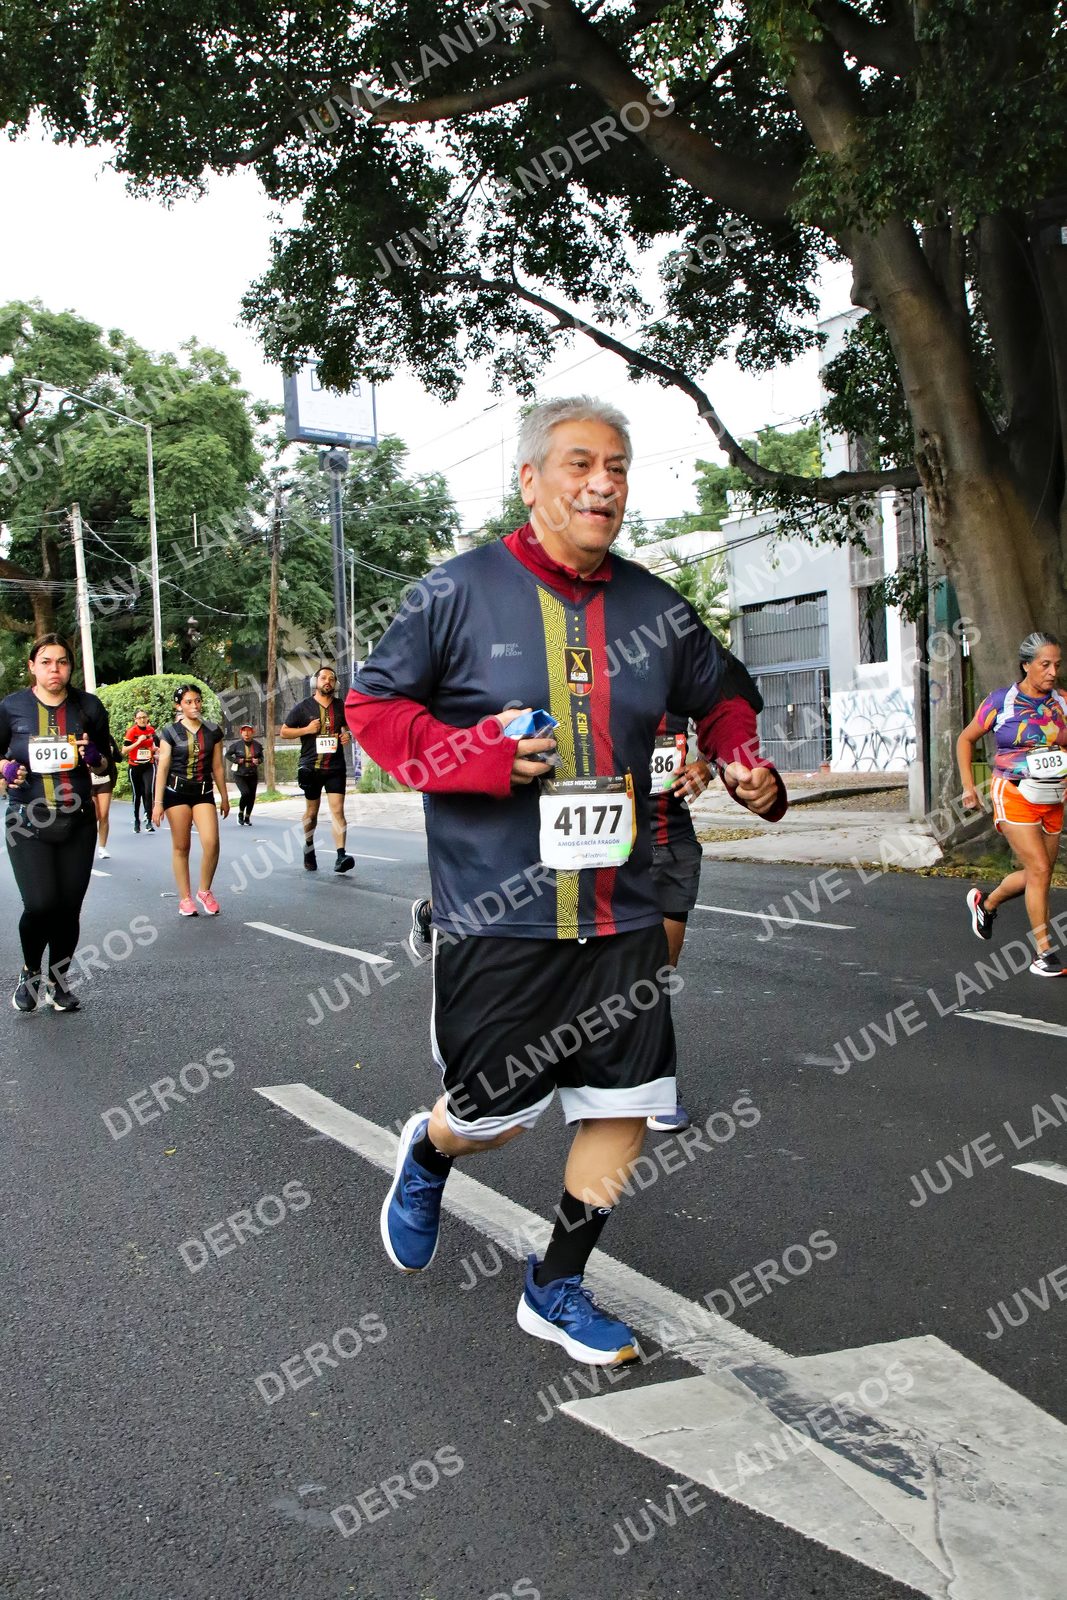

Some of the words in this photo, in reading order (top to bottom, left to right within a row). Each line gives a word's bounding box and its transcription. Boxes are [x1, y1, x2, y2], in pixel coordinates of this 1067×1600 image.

[319, 739, 335, 747] 4112
[35, 748, 68, 760] 6916
[1034, 755, 1063, 770] 3083
[553, 805, 623, 836] 4177
